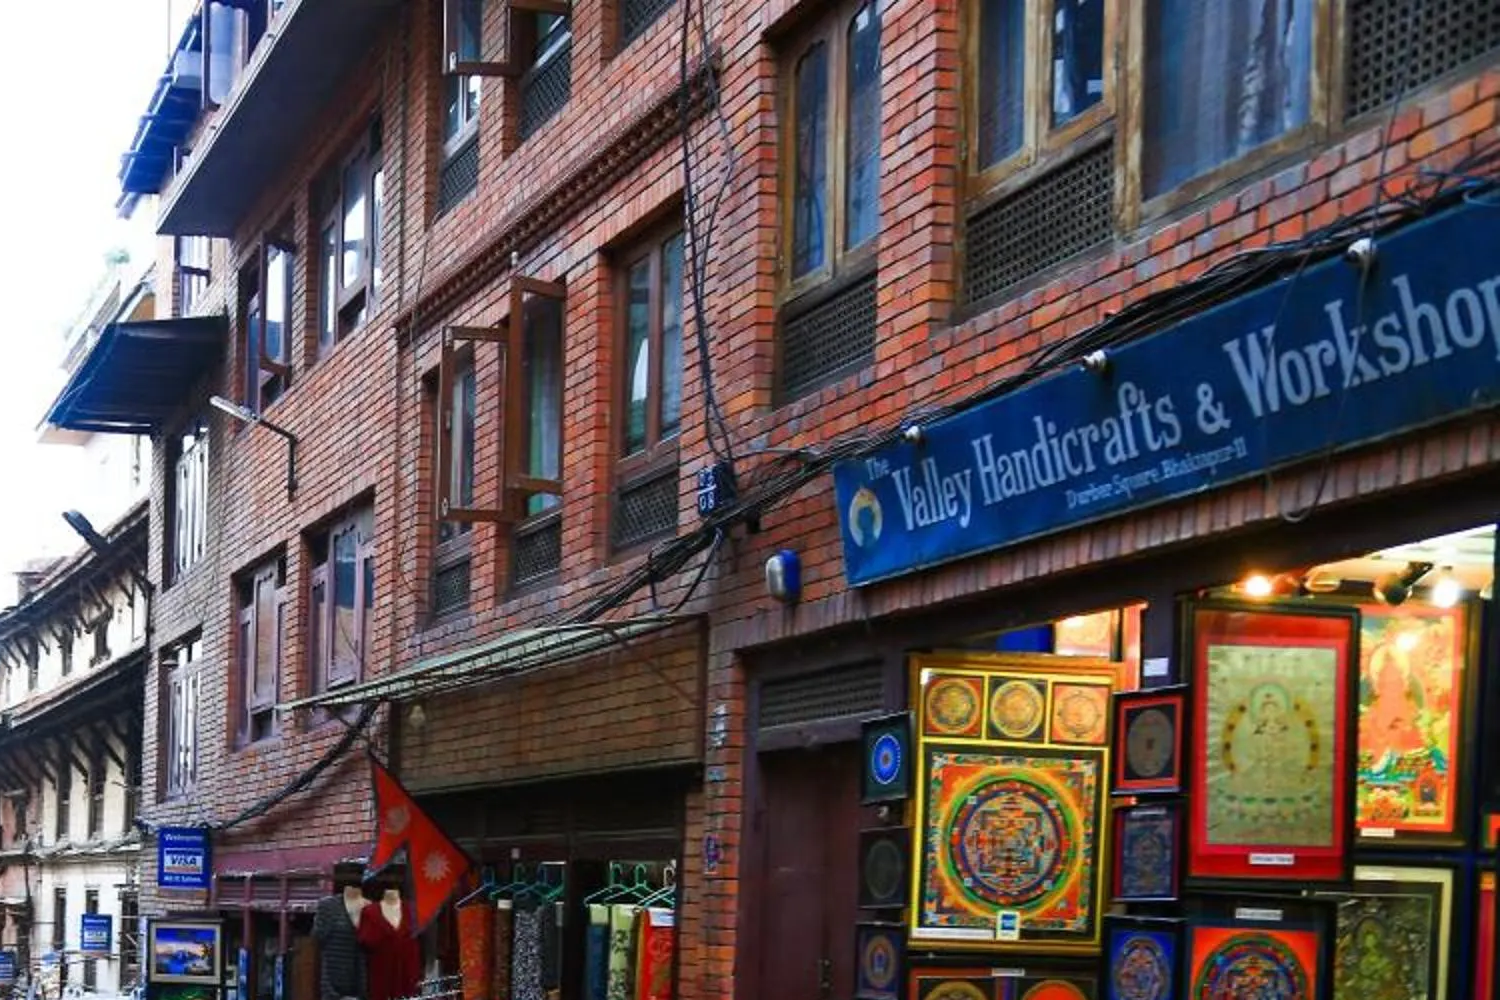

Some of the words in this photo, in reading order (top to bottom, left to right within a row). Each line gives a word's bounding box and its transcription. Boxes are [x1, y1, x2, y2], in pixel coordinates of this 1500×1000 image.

[866, 457, 891, 481] The
[891, 457, 973, 532] Valley
[971, 380, 1184, 506] Handicrafts
[1197, 382, 1232, 435] &
